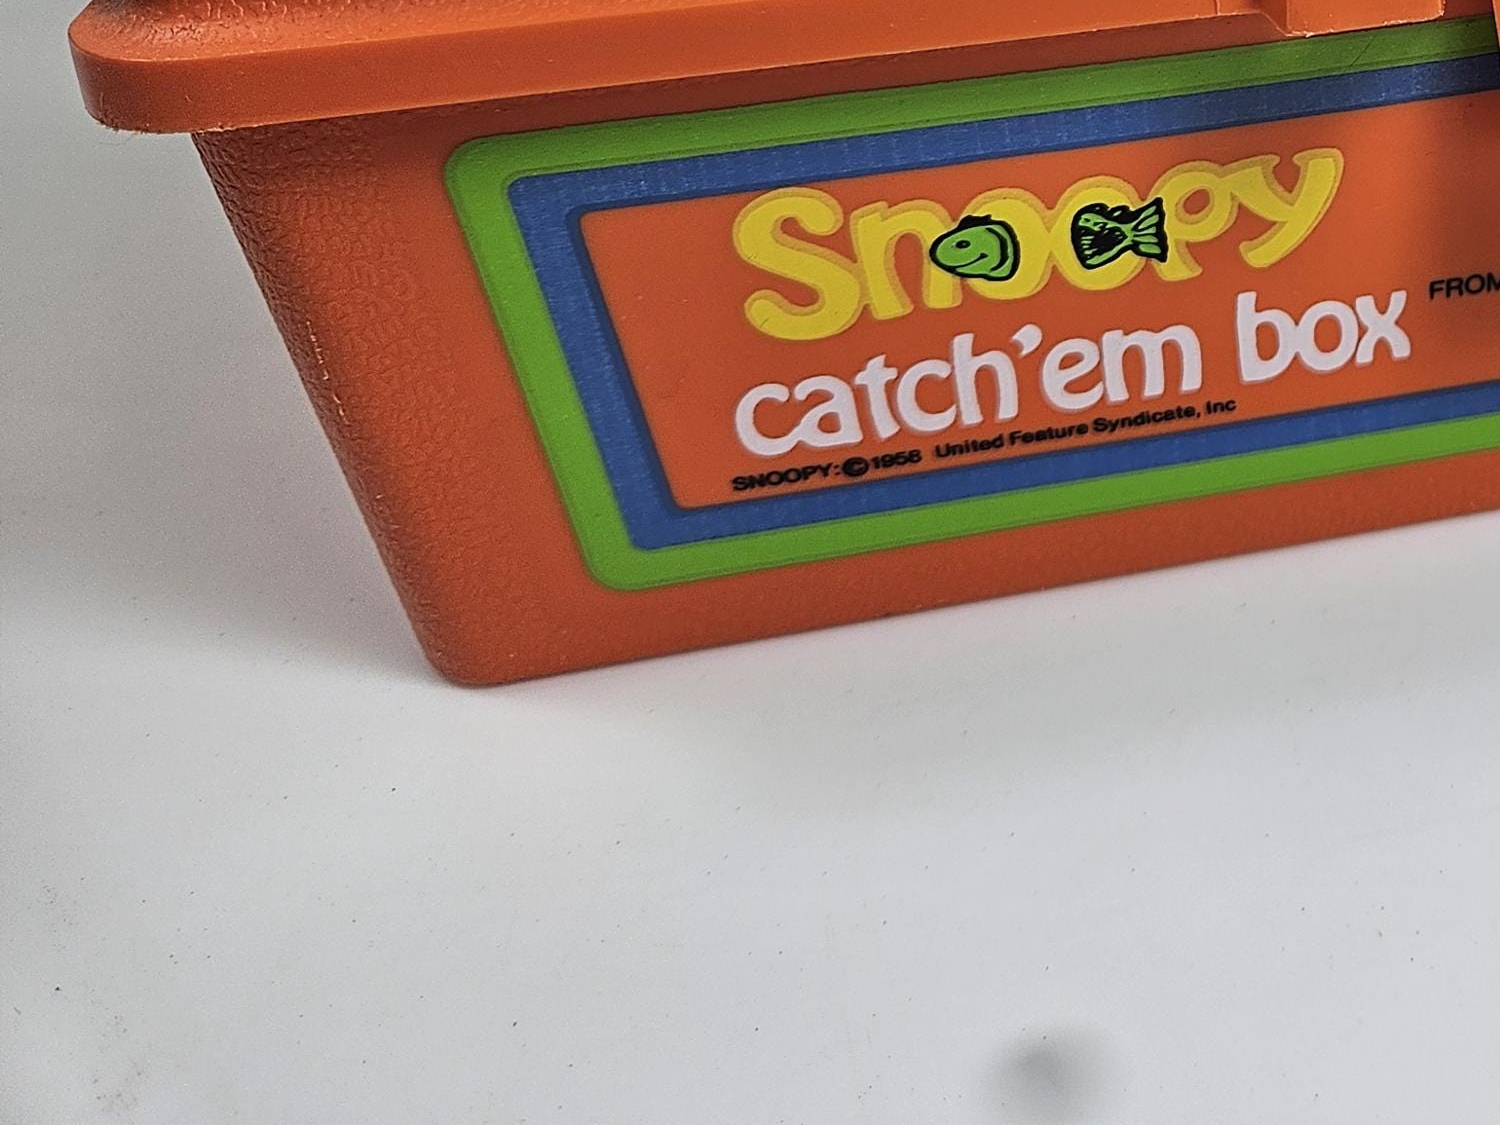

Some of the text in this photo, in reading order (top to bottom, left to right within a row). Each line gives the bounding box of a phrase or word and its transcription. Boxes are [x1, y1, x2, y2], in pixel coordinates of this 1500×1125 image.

[732, 147, 1345, 341] Snoopy
[734, 290, 1412, 457] catch'em box
[935, 433, 1005, 459] United
[1009, 421, 1088, 446] Feature
[1092, 408, 1201, 434] Syndicate,
[1206, 397, 1237, 415] Inc
